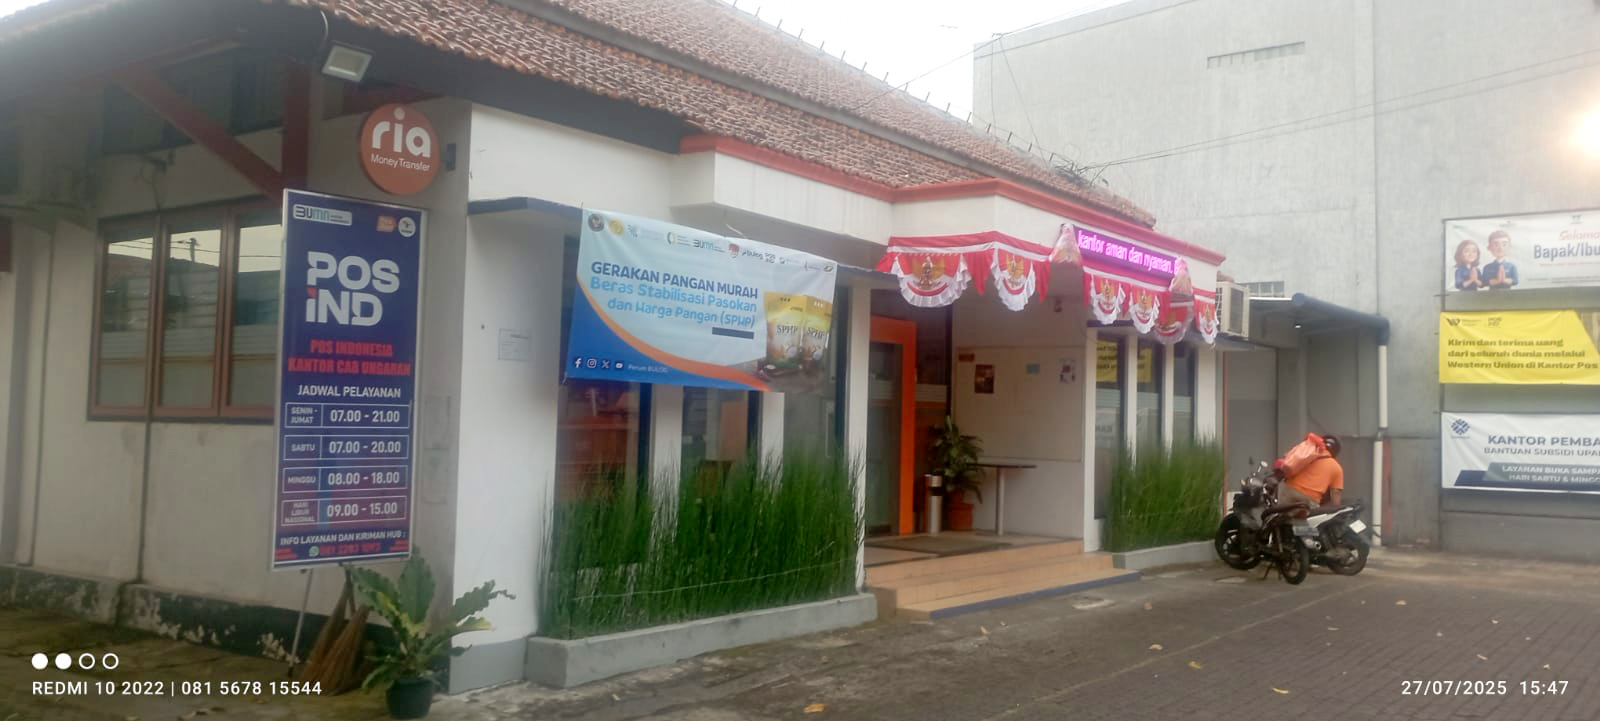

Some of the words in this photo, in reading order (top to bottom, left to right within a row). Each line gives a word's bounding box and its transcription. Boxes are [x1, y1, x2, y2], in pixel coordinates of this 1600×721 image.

[372, 107, 431, 158] ria
[371, 153, 398, 168] Money
[398, 158, 430, 171] Transfer
[1078, 229, 1105, 254] kantor
[1105, 242, 1127, 260] aman
[1128, 246, 1144, 265] dan
[1143, 253, 1173, 274] nyaman.
[1534, 243, 1600, 261] Bapak/Ibu
[306, 251, 400, 294] POS
[590, 261, 660, 283] GERAKAN
[662, 272, 715, 293] PANGAN
[717, 281, 758, 299] MURAH
[590, 276, 634, 295] Beras
[637, 283, 705, 305] Stabilisasi
[707, 294, 757, 313] Pasokan
[607, 297, 633, 312] dan
[635, 304, 673, 319] Harga
[675, 307, 717, 324] Pangan
[720, 310, 756, 328] (SPHP)
[310, 339, 333, 354] POS
[336, 341, 393, 357] INDONESIA
[1448, 350, 1468, 358] dari
[288, 357, 334, 373] KANTOR
[337, 360, 359, 375] CAB
[1447, 361, 1492, 369] Western
[1493, 361, 1525, 369] Union
[1525, 361, 1536, 369] di
[1537, 361, 1576, 369] Kantor
[1576, 361, 1598, 369] Pos
[298, 384, 341, 397] JADWAL
[343, 386, 401, 398] PELAYANAN
[330, 409, 361, 422] 07.00
[372, 410, 400, 423] 21.00
[291, 443, 316, 452] SABTU
[329, 441, 360, 454] 07.00
[371, 441, 401, 453] 20.00
[1488, 435, 1546, 446] KANTOR
[1551, 437, 1600, 447] PEMBA
[1484, 448, 1532, 456] BANTUAN
[1534, 448, 1574, 457] SUBSIDI
[1502, 465, 1543, 474] LAYANAN
[1544, 467, 1569, 475] BUKA
[287, 475, 316, 484] MINGGU
[327, 473, 360, 486] 08.00
[371, 471, 400, 484] 18.00
[326, 504, 359, 518] 09.00
[370, 502, 398, 516] 15.00
[280, 537, 299, 545] INFO
[300, 533, 337, 544] LAYANAN
[338, 534, 354, 542] DAN
[355, 531, 385, 541] KIRIMAN
